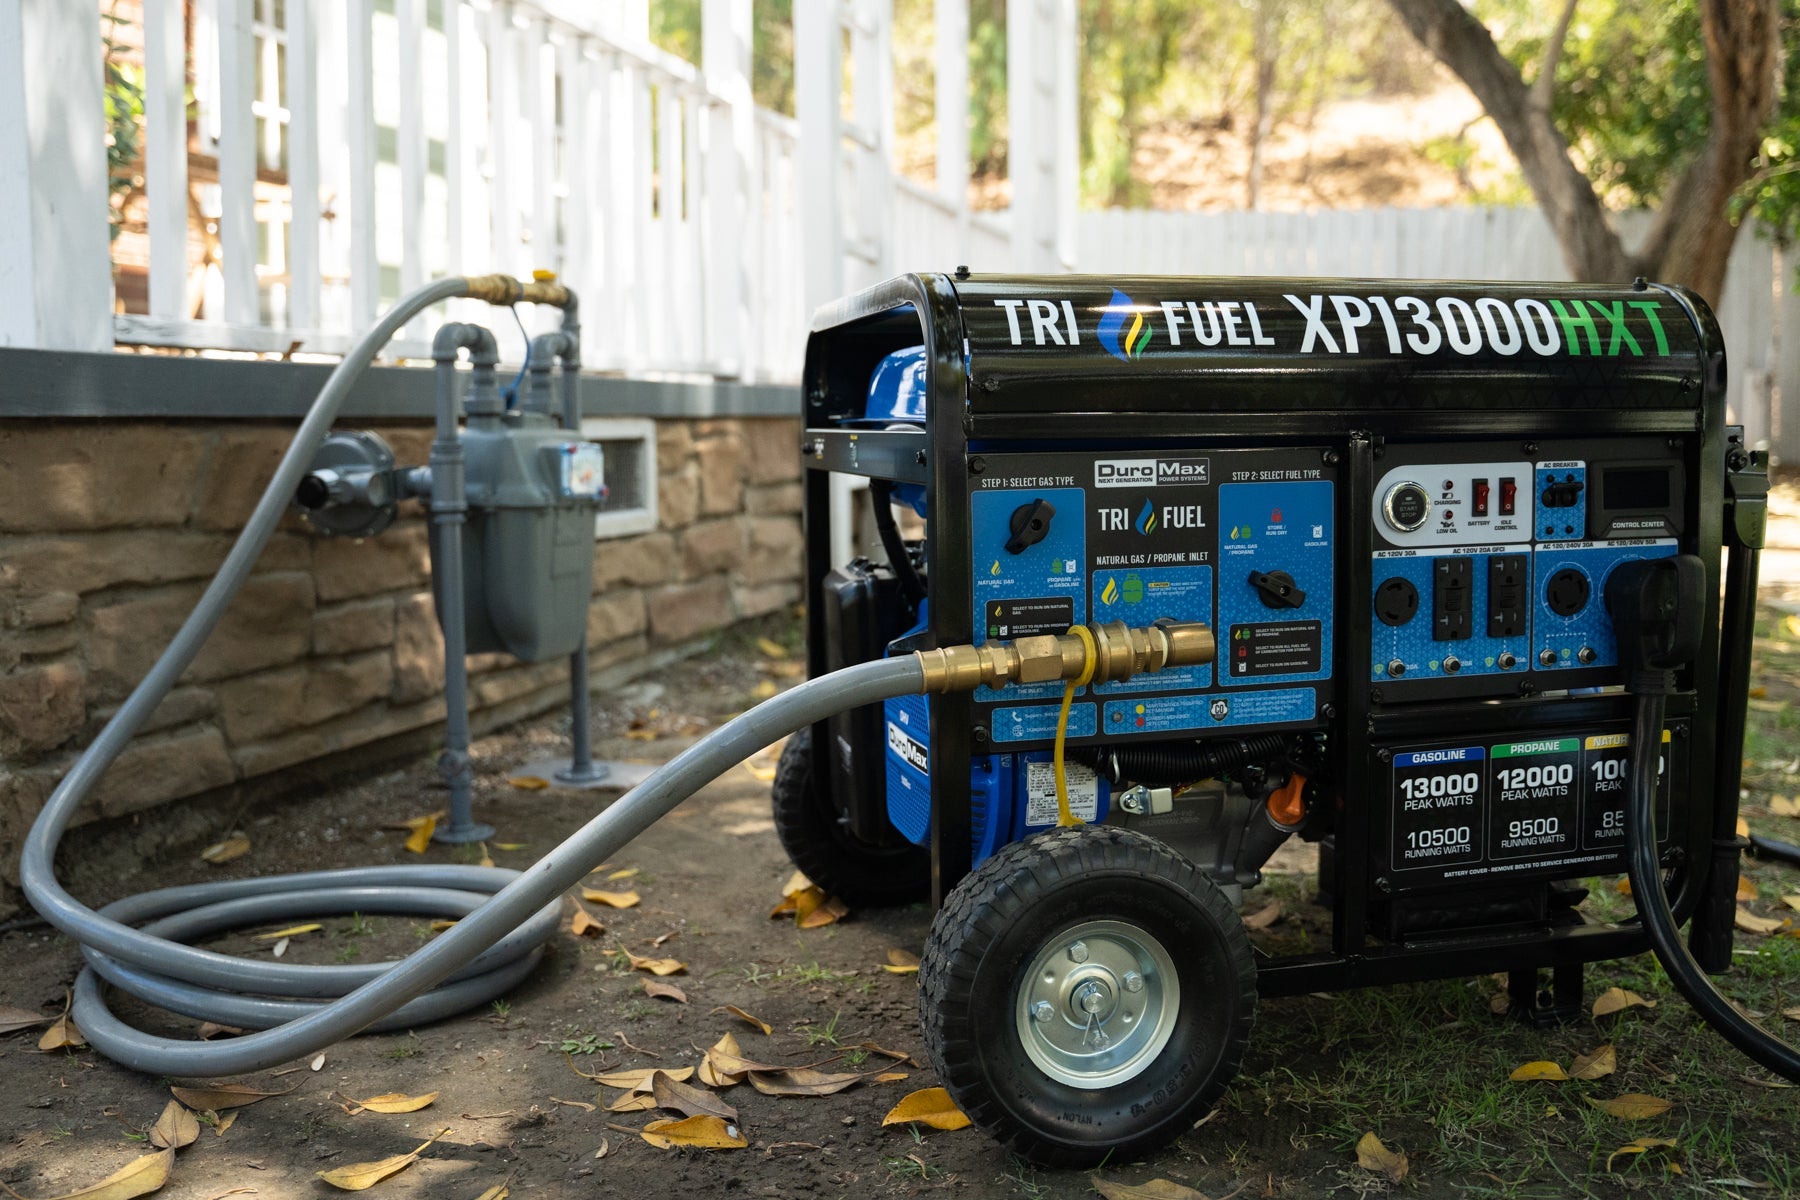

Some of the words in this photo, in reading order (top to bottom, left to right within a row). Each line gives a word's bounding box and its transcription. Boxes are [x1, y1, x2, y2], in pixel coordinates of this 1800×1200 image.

[994, 299, 1080, 345] TRI
[1160, 301, 1275, 346] FUEL
[1282, 294, 1670, 356] XP13000HXT
[982, 478, 1001, 488] STEP
[1003, 478, 1008, 487] 1:
[1010, 477, 1037, 487] SELECT
[1039, 477, 1054, 486] GAS
[1055, 476, 1074, 486] TYPE
[1232, 471, 1250, 480] STEP
[1251, 472, 1258, 480] 2:
[1260, 470, 1284, 480] SELECT
[1286, 470, 1301, 479] FUEL
[1303, 470, 1320, 479] TYPE
[1098, 508, 1129, 531] TRI
[1163, 506, 1206, 528] FUEL
[1096, 555, 1129, 565] NATURAL
[1131, 555, 1144, 564] GAS
[1154, 553, 1185, 562] PROPANE
[1189, 552, 1208, 561] INLET
[1215, 704, 1224, 713] CO
[1510, 741, 1560, 754] PROPANE
[1594, 735, 1628, 746] NATUR
[1412, 750, 1466, 763] GASOLINE
[1497, 764, 1573, 790] 12000
[1400, 773, 1478, 799] 13000
[1595, 780, 1622, 792] PEAK
[1502, 789, 1529, 801] PEAK
[1532, 786, 1568, 798] WATTS
[1405, 799, 1433, 810] PEAK
[1436, 795, 1473, 807] WATTS
[1509, 817, 1558, 838] 9500
[1595, 828, 1624, 838] RUNNIN
[1407, 827, 1470, 848] 10500
[1501, 837, 1537, 848] RUNNING
[1539, 834, 1565, 844] WATTS
[1405, 847, 1442, 859] RUNNING
[1444, 844, 1471, 854] WATTS
[1444, 870, 1468, 878] BATTERY
[1491, 865, 1514, 873] REMOVE
[1540, 859, 1562, 867] SERVICE
[1563, 856, 1594, 865] GENERATOR
[1595, 853, 1618, 861] BATTERY
[1063, 1111, 1092, 1125] NYLON
